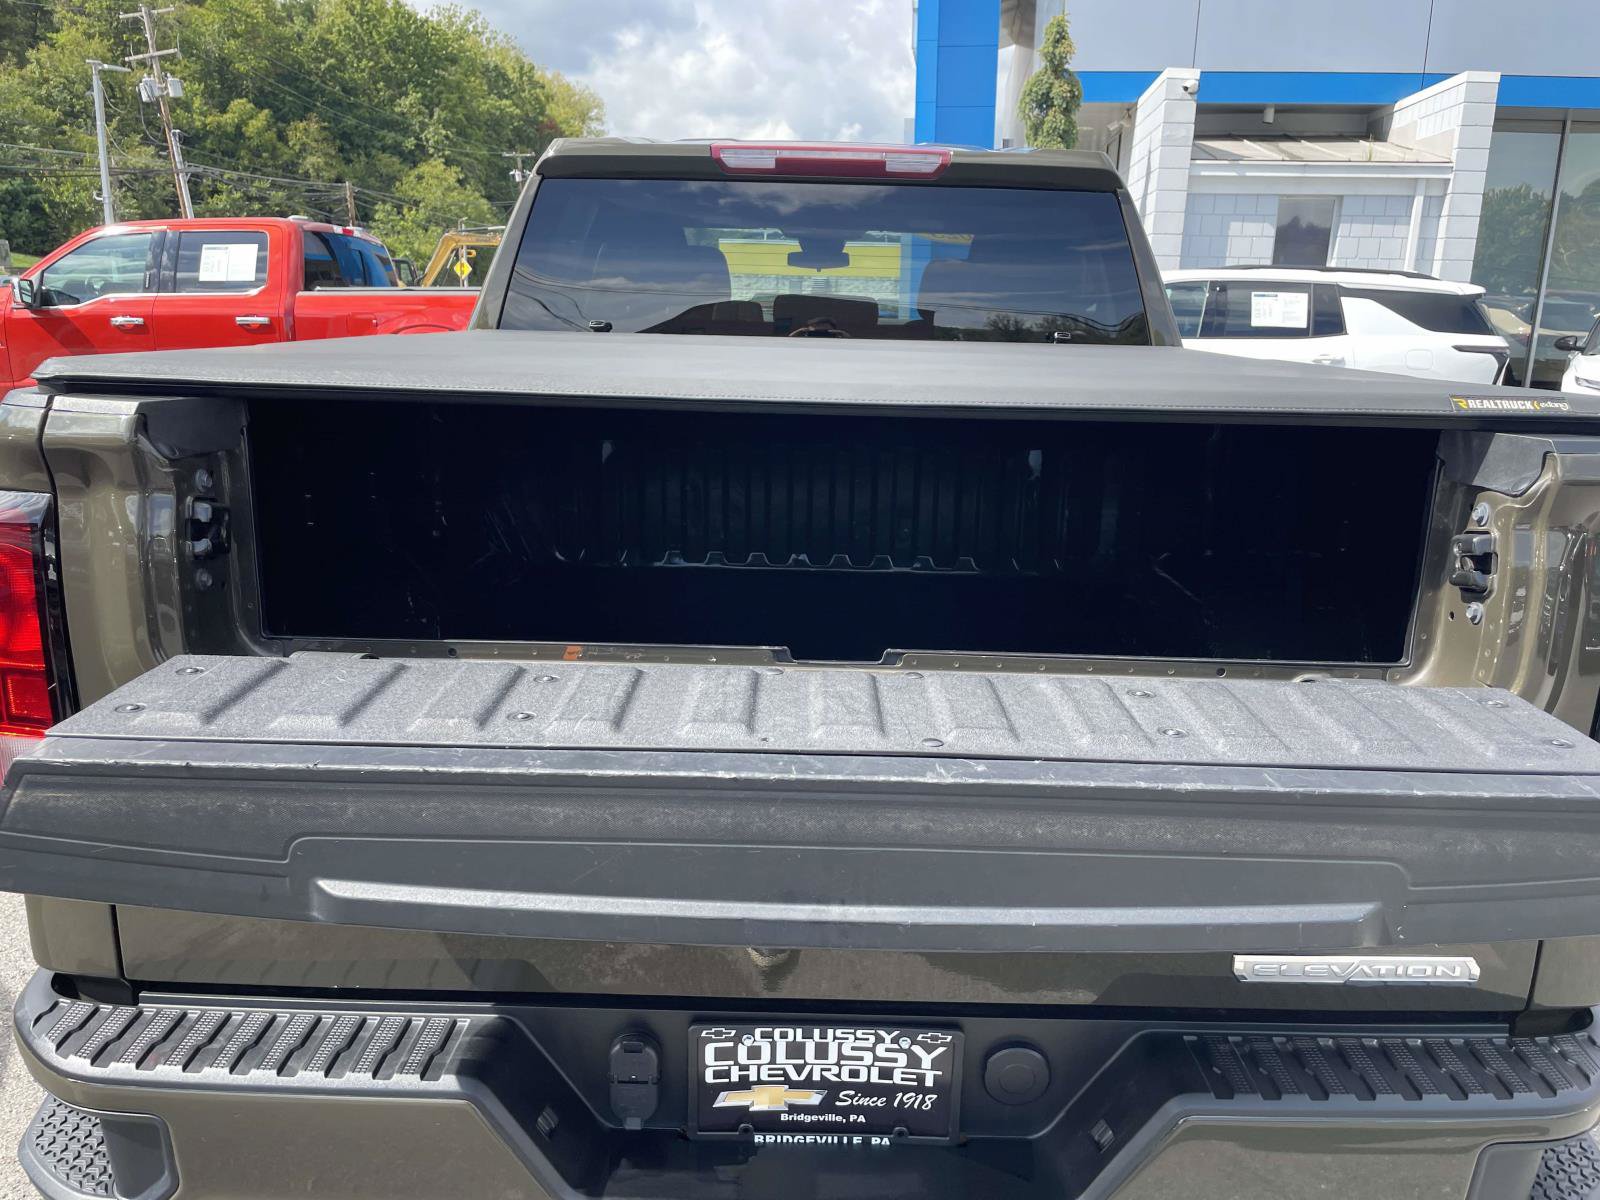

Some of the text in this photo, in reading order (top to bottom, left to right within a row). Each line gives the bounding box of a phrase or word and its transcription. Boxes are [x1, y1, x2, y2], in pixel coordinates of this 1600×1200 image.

[1467, 399, 1534, 410] REALTRUCK
[1253, 962, 1462, 978] ELEVATION
[754, 1027, 901, 1044] COLUSSY
[704, 1041, 948, 1070] COLUSSY
[704, 1064, 943, 1087] CHEVROLET
[835, 1089, 938, 1110] Since 1918
[780, 1113, 867, 1123] Bridgeville, PA
